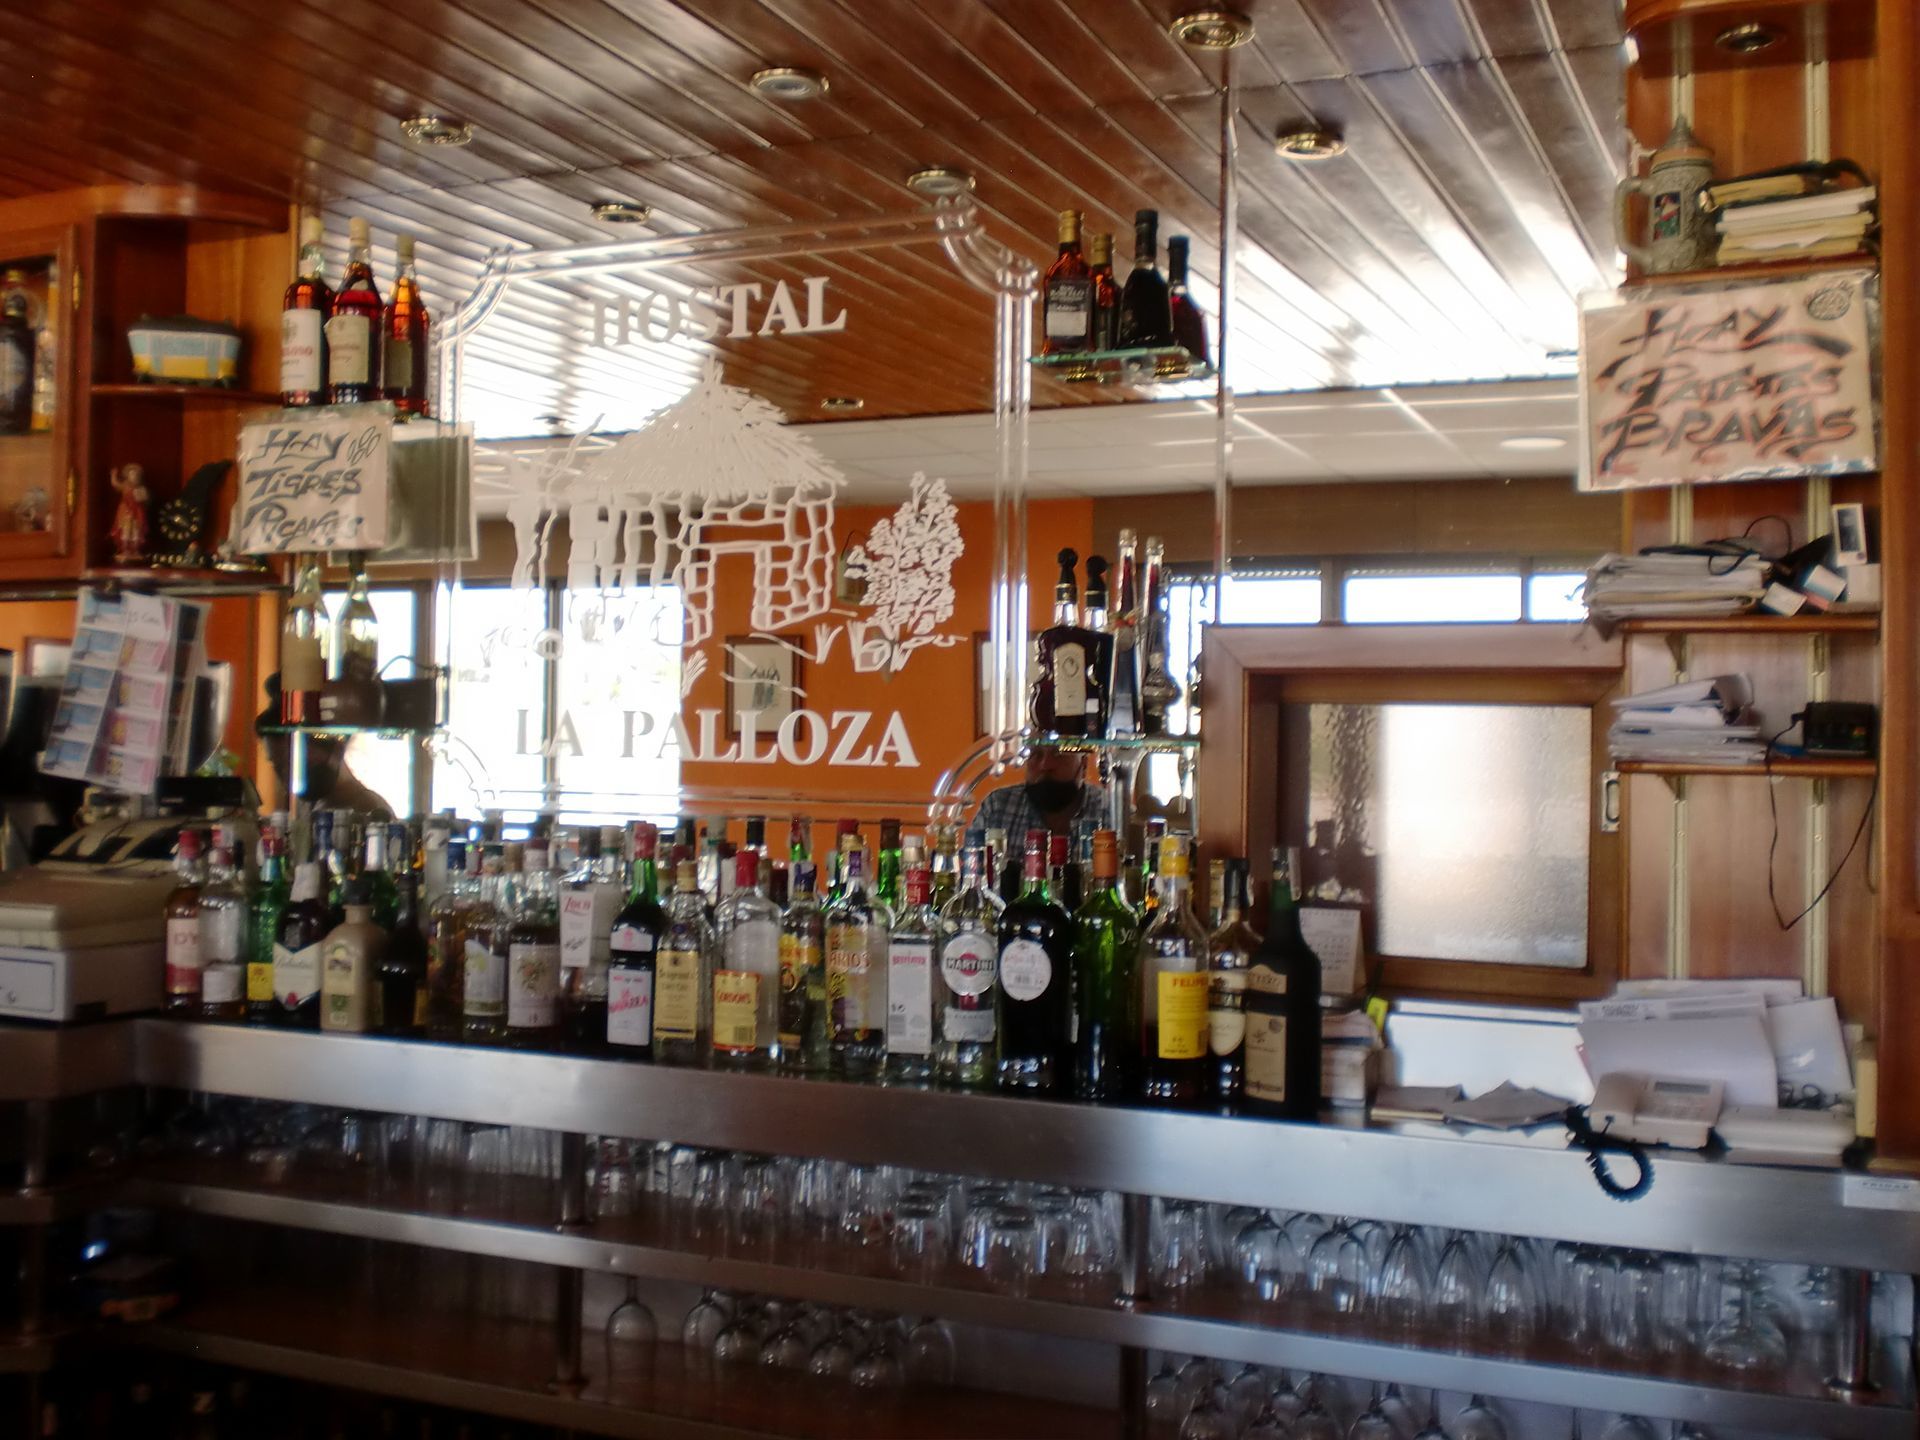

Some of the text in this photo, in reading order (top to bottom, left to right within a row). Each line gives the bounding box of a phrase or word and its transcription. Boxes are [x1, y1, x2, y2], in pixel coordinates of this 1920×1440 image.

[589, 276, 848, 348] HOSTAL
[246, 428, 351, 472] HAY
[1602, 399, 1857, 473] BRAVAS
[245, 465, 363, 504] TIGRES
[515, 708, 921, 768] LA PALLOZA
[945, 957, 995, 973] MARTINI
